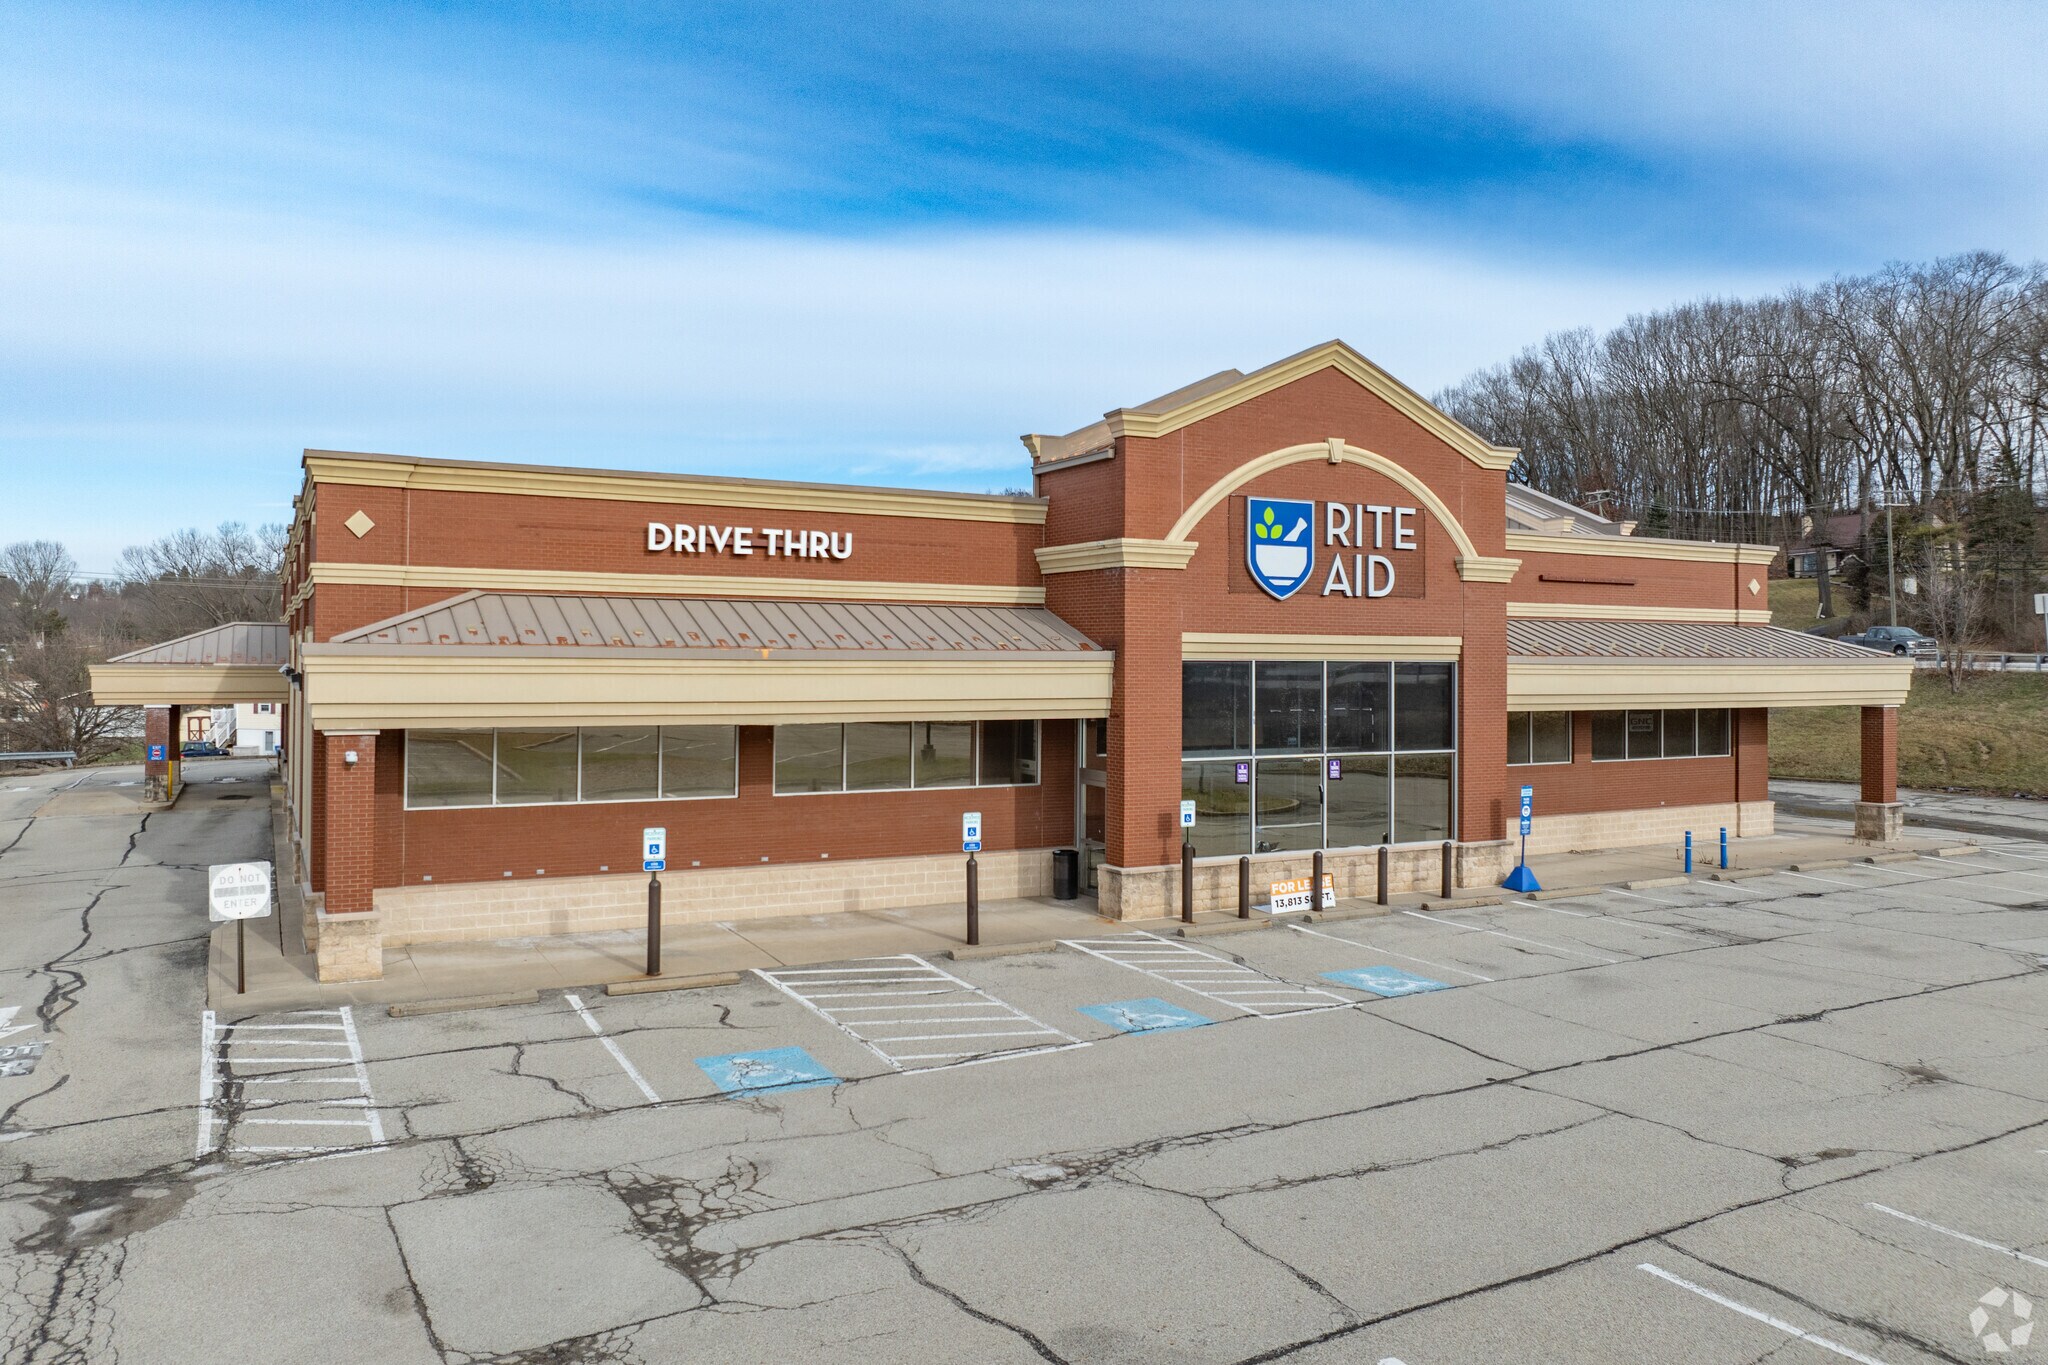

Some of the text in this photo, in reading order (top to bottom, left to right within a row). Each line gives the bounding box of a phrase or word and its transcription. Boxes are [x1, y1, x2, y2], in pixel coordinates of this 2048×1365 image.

[1325, 502, 1417, 550] RITE
[648, 522, 853, 559] DRIVE THRU
[1322, 553, 1396, 598] AID
[220, 874, 260, 885] DO NOT
[1271, 876, 1331, 895] FOR LEE
[224, 898, 257, 909] ENTER
[1275, 896, 1302, 908] 13,813
